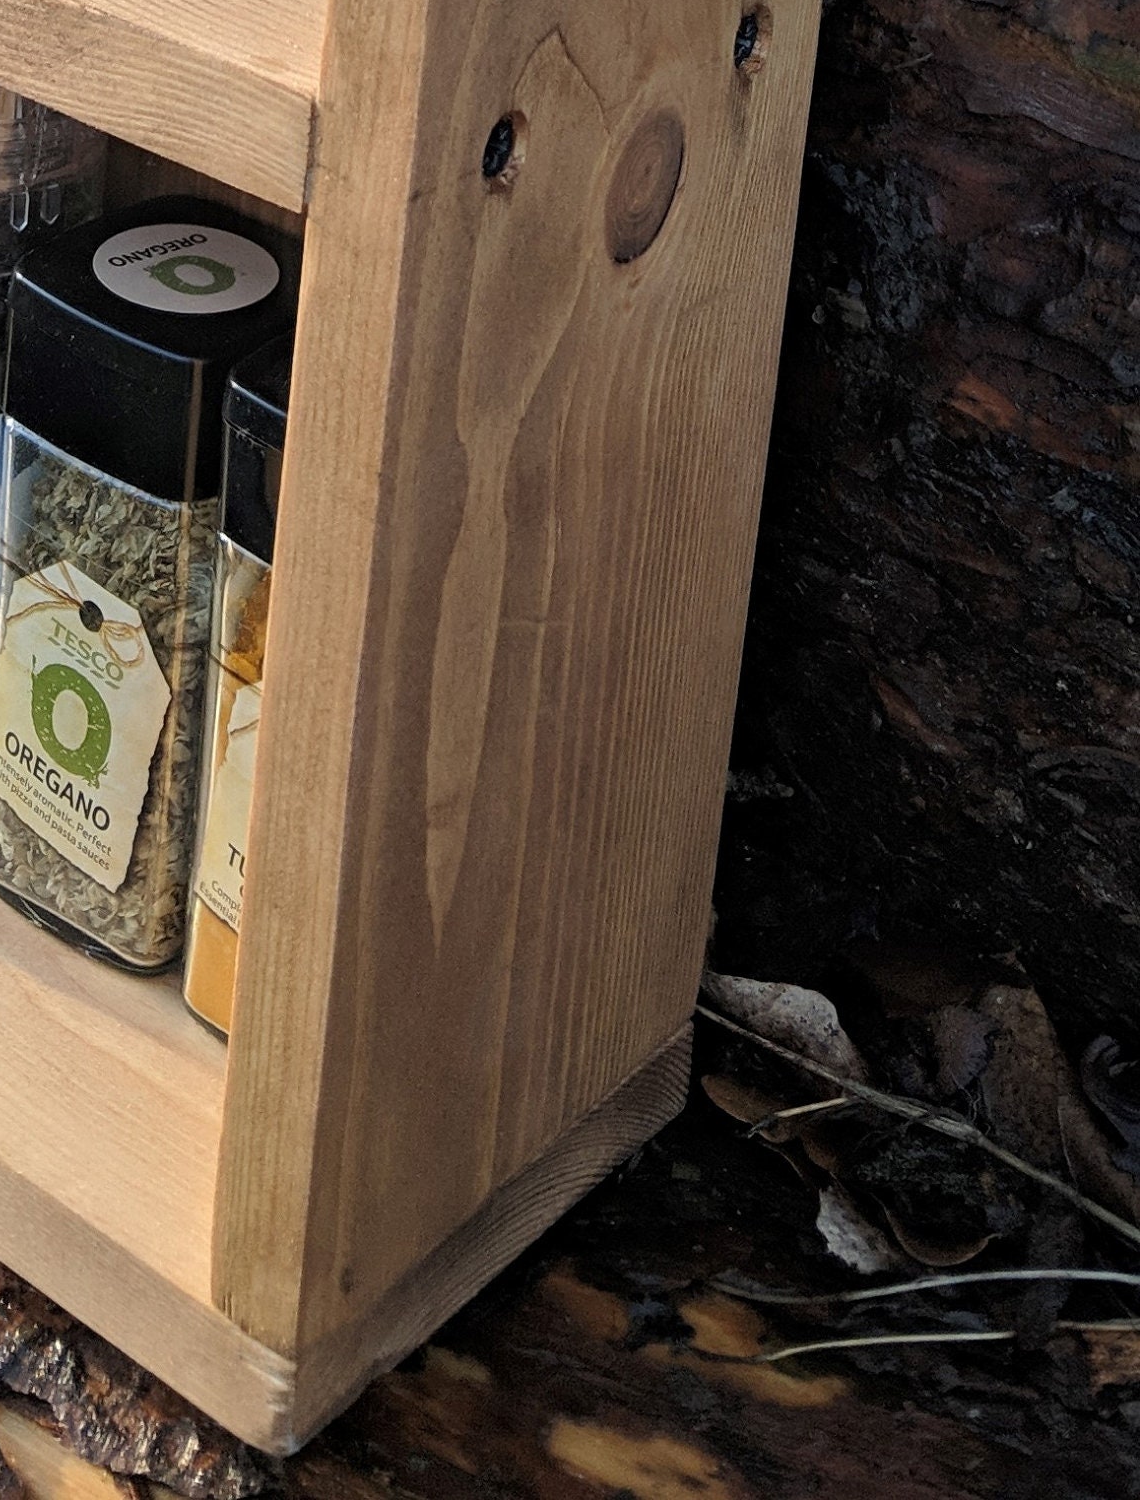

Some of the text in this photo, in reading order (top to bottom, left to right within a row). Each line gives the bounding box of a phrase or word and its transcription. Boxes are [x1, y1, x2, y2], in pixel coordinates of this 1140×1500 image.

[107, 232, 208, 268] OREGANO
[50, 616, 125, 683] TESCO
[31, 660, 113, 784] O
[4, 731, 112, 832] OREGANO
[10, 782, 34, 809] pizza
[32, 803, 52, 824] and
[50, 819, 78, 846] pasta
[76, 839, 111, 871] sauces
[75, 822, 113, 858] Perfect
